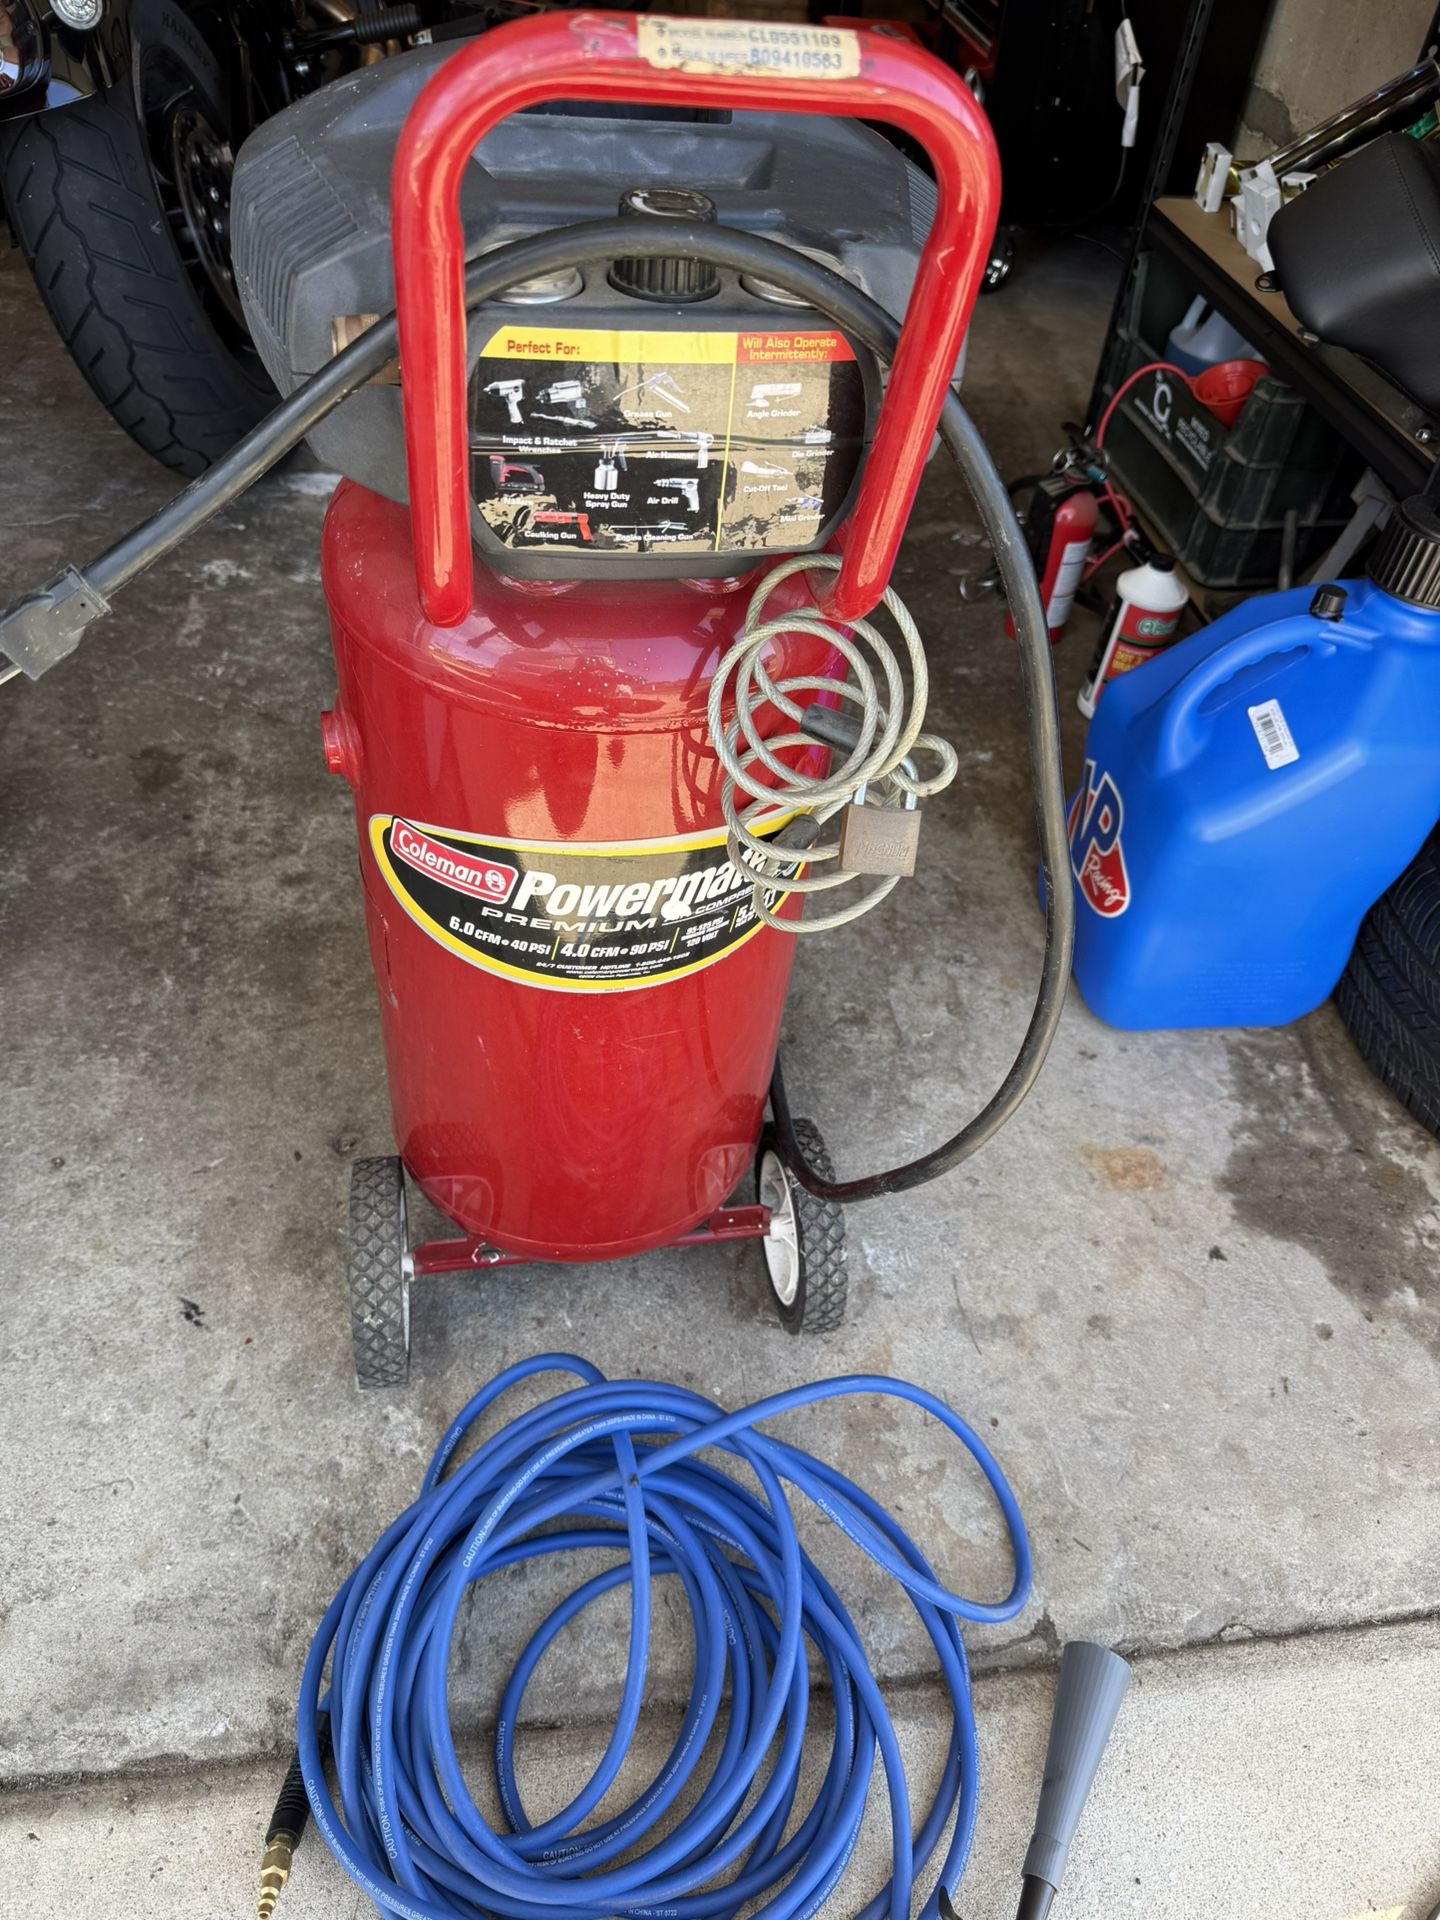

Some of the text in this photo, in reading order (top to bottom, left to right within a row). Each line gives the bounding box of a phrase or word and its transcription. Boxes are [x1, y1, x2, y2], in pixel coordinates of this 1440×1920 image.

[507, 339, 580, 356] Perfect For:
[742, 336, 838, 351] Will Also Operate
[749, 348, 829, 361] Intermittently:
[623, 409, 673, 419] Grease Gun
[746, 409, 801, 420] Angle Grinder
[502, 435, 578, 447] Impact & Ratchet
[518, 445, 562, 454] Wrenches
[646, 451, 696, 459] Air Hammer
[791, 449, 835, 458] Die Grinder
[743, 484, 789, 494] Cut-Off Tool
[583, 491, 631, 502] Heavy Duty
[647, 497, 679, 505] Air Drill
[585, 500, 629, 510] Spray Gun
[779, 513, 826, 523] Mini Grinder
[524, 530, 577, 541] Caulking Gun
[615, 533, 694, 543] Engine Cleaning Gun
[398, 829, 483, 887] Coleman
[1084, 852, 1128, 907] Racing
[481, 905, 658, 933] PREMIUM
[449, 915, 551, 955] 6.0 CFM 40 PSI
[686, 936, 701, 948] 120
[701, 929, 720, 943] VOLT
[560, 939, 670, 958] 4.0 CFM 90 PSI
[536, 961, 632, 971] 24/7 CUSTOMER HOTLINE
[410, 1561, 421, 1578] CHINA
[389, 1621, 398, 1637] THAN
[383, 1638, 394, 1666] GREATER
[377, 1667, 388, 1704] PRESSURES
[377, 1704, 383, 1713] AT
[377, 1787, 384, 1796] OF
[380, 1810, 398, 1860] CAUTION:
[306, 1778, 325, 1820] CAUTION:
[326, 1830, 335, 1840] OF
[355, 1871, 366, 1881] NOT
[364, 1879, 376, 1890] USE
[373, 1887, 381, 1895] AT
[380, 1892, 414, 1915] PRESSURES
[634, 1908, 652, 1917] CHINA
[655, 1909, 664, 1917] ST
